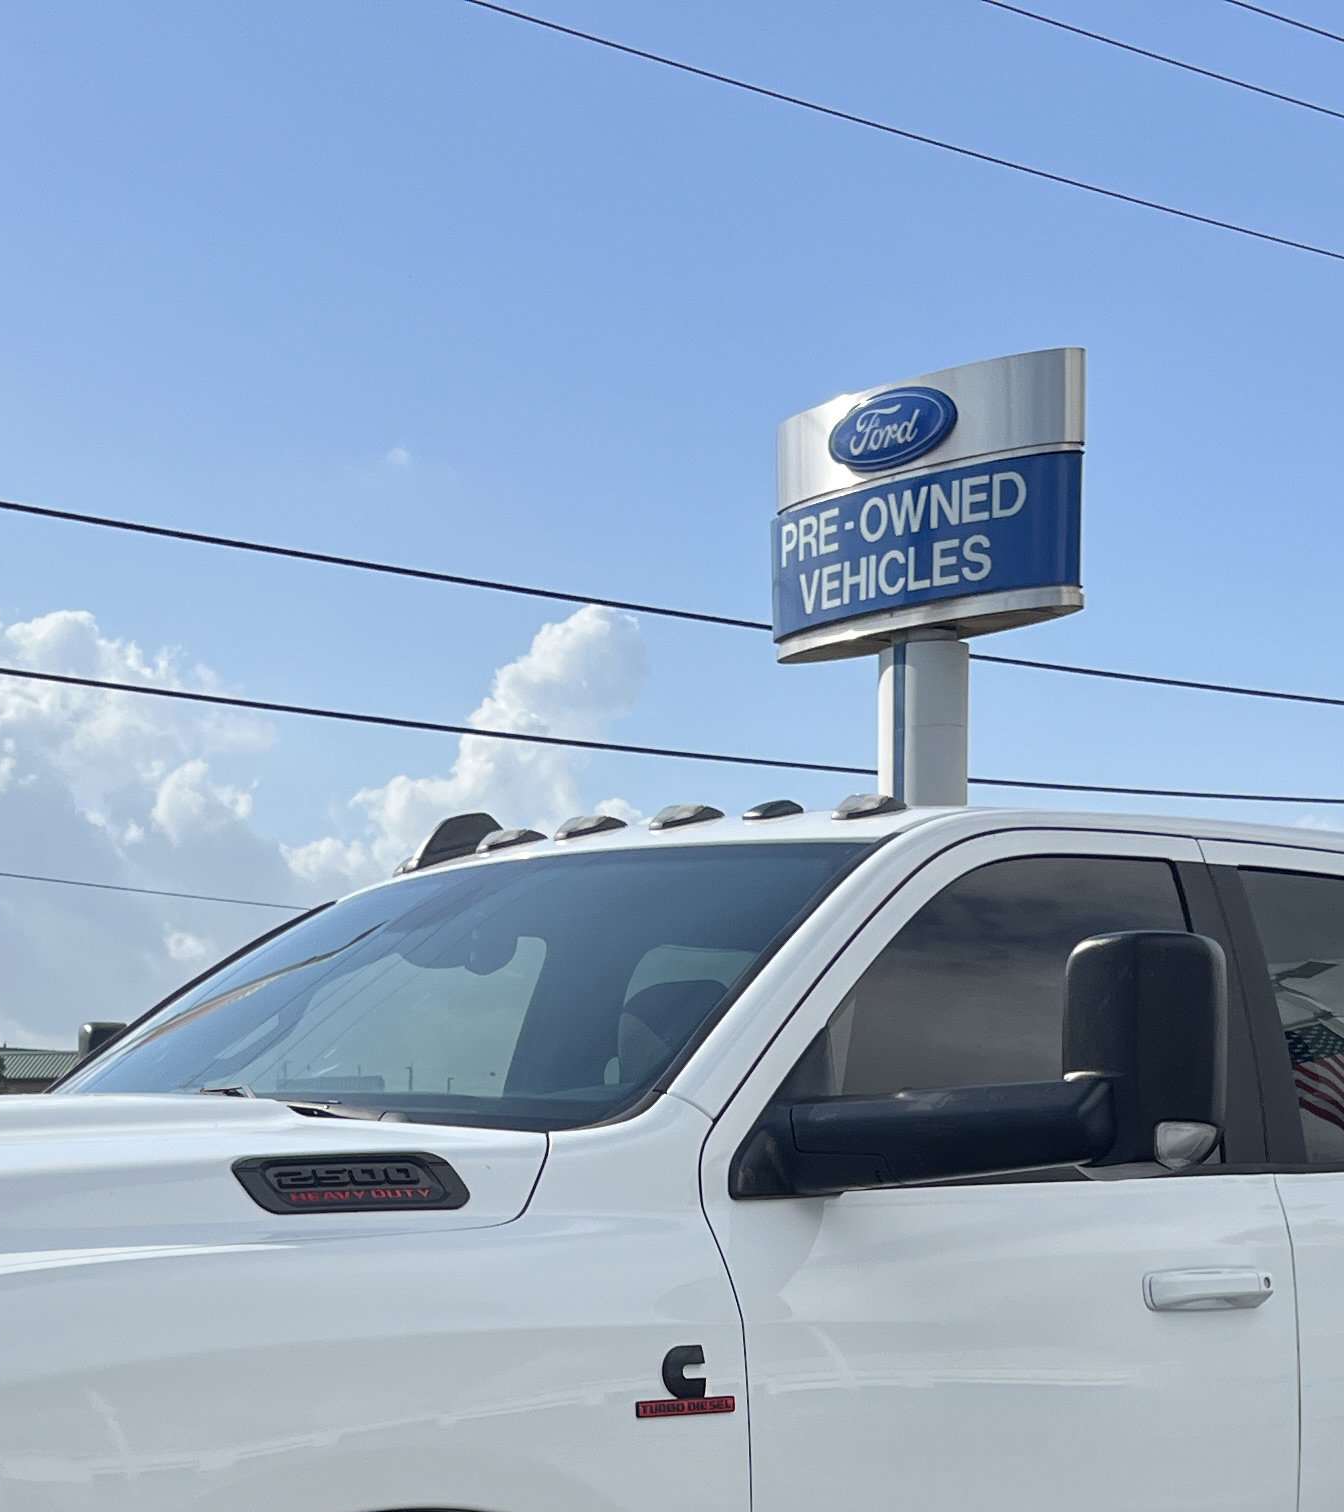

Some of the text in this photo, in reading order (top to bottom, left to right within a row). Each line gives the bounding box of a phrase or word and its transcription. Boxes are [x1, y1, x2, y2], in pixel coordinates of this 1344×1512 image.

[849, 403, 920, 456] Ford
[781, 471, 1027, 568] PRE-OWNED
[799, 535, 992, 615] VEHICLES
[274, 1167, 420, 1189] 2500
[289, 1188, 430, 1201] HEAVY DUTY
[641, 1400, 732, 1415] TURBO DIESEL
